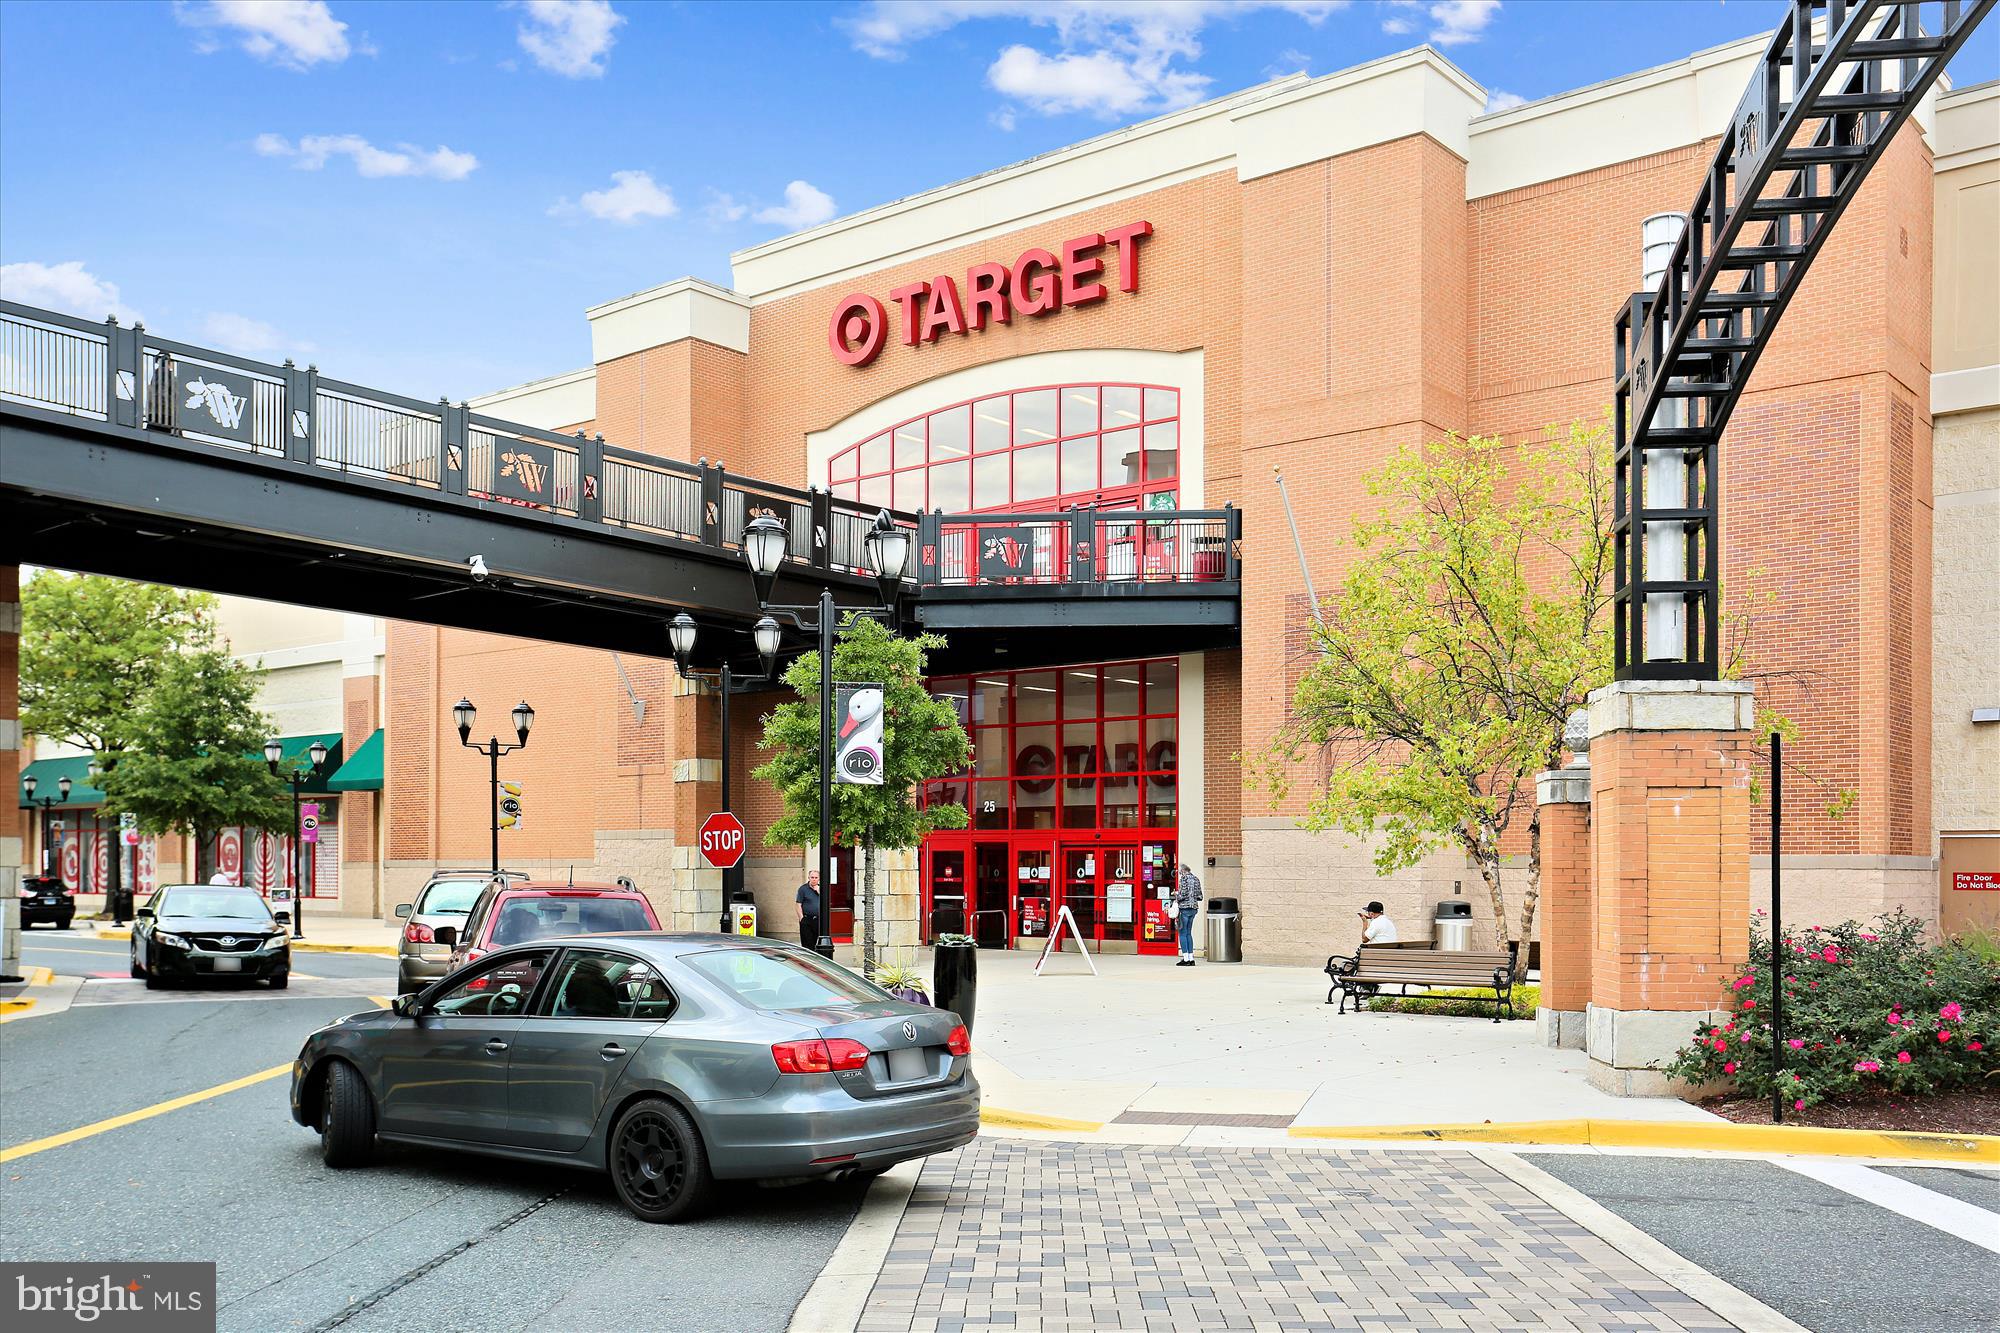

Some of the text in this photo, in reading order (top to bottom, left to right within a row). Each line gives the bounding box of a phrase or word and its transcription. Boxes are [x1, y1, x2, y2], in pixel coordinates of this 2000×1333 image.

[890, 220, 1153, 346] TARGET
[849, 757, 871, 768] rio
[504, 801, 518, 809] rio
[983, 801, 996, 812] 25
[703, 829, 742, 851] STOP
